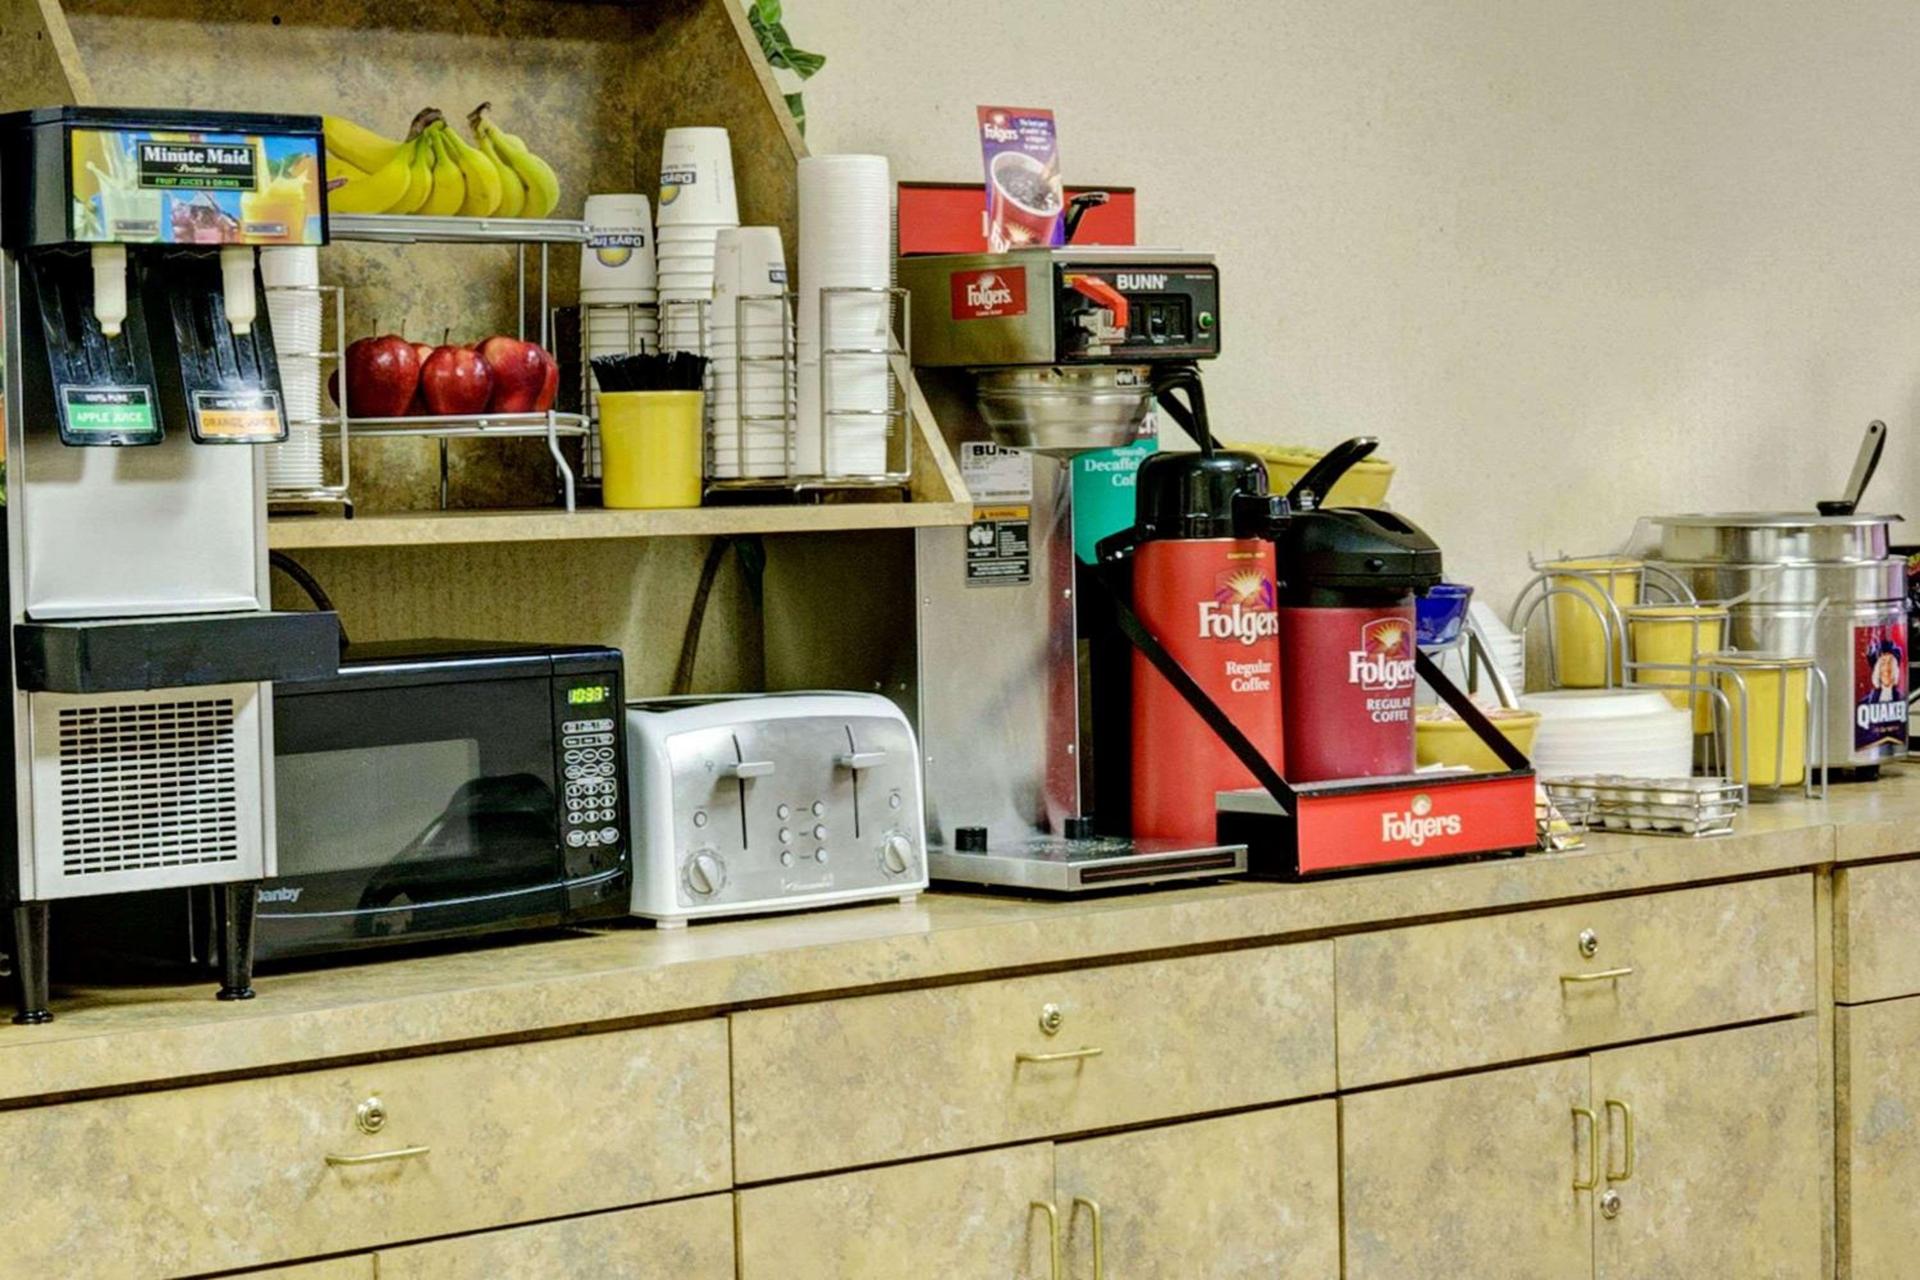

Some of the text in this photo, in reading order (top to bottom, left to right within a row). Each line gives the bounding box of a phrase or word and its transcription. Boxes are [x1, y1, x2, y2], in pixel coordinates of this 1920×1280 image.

[983, 123, 1018, 143] Folgers
[143, 146, 250, 165] Minute Maid
[608, 236, 641, 248] Days
[1117, 274, 1164, 290] BUNN
[967, 284, 1013, 310] Folgers
[77, 411, 145, 424] APPLE JUICE
[1225, 660, 1272, 678] Regular
[1231, 678, 1271, 692] Coffee
[1382, 811, 1462, 847] Folgers
